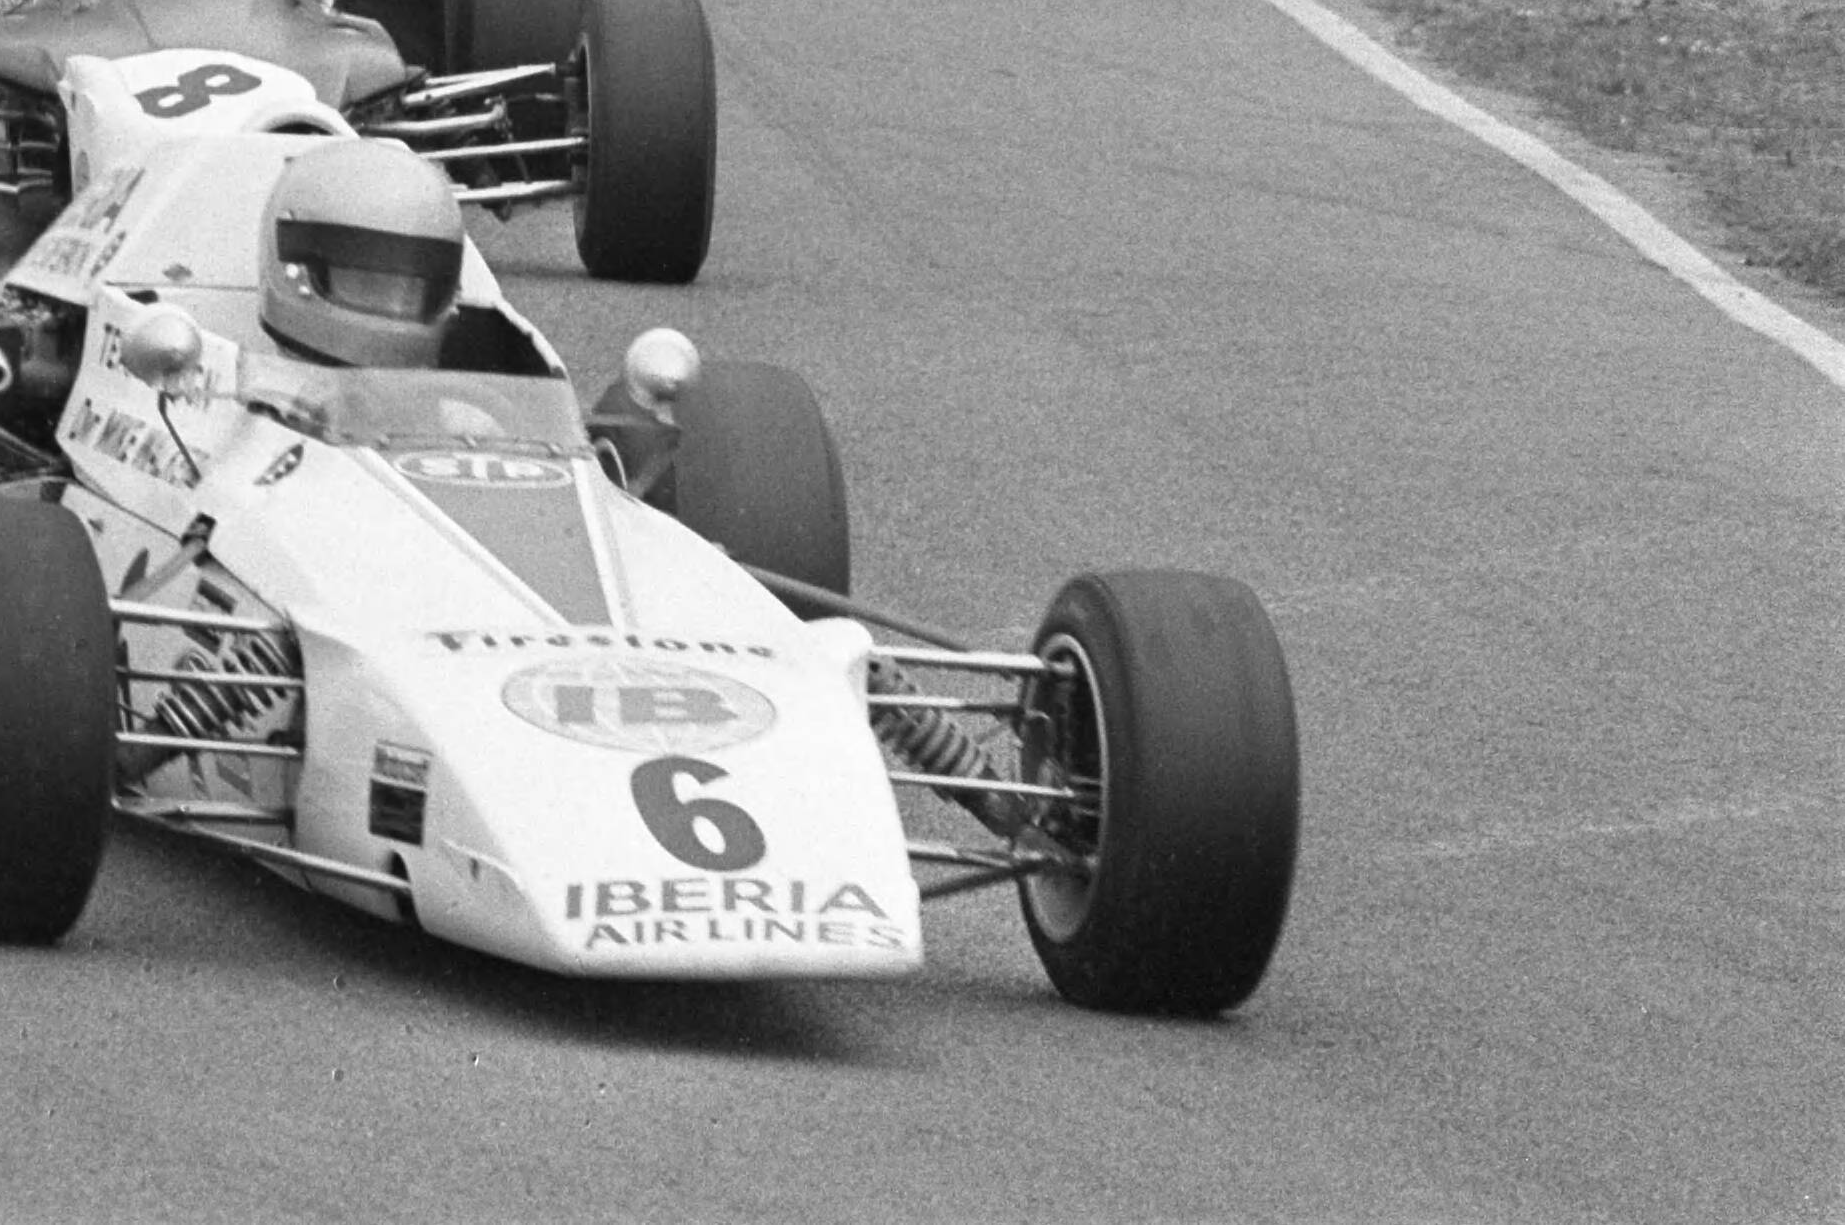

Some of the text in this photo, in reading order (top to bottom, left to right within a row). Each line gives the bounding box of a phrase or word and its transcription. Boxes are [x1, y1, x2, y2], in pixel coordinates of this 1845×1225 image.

[132, 63, 262, 119] 8
[630, 755, 767, 873] 6
[565, 876, 888, 921] IBERIA
